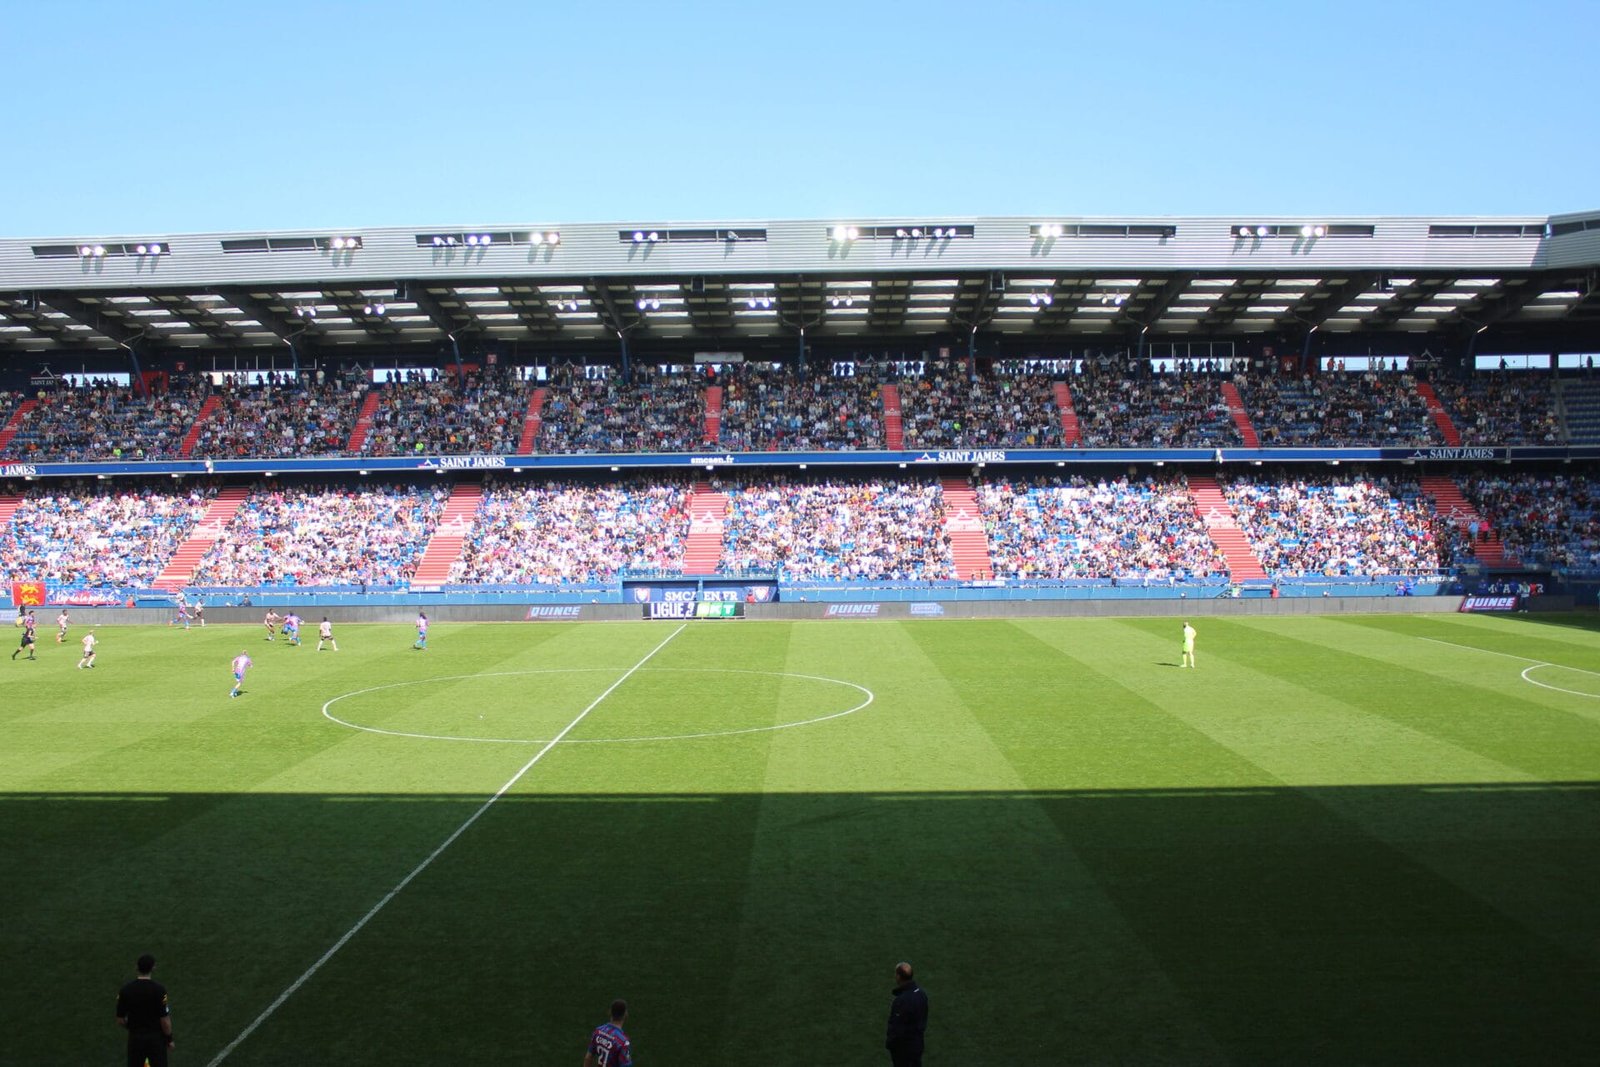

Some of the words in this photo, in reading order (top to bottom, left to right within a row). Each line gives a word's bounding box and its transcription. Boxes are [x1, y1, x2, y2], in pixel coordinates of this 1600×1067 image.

[939, 452, 970, 461] SAINT
[972, 451, 1005, 461] JAMES
[1430, 449, 1460, 458] SAINT
[1461, 449, 1494, 459] JAMES
[440, 457, 471, 467] SAINT
[472, 457, 505, 467] JAMES
[691, 455, 734, 464] smcaen.fr
[5, 465, 36, 475] JAMES
[1465, 597, 1515, 608] QUINCE
[530, 606, 581, 617] QUINCE
[651, 602, 684, 617] LIGUE
[685, 602, 695, 617] 2
[829, 604, 880, 615] QUINCE
